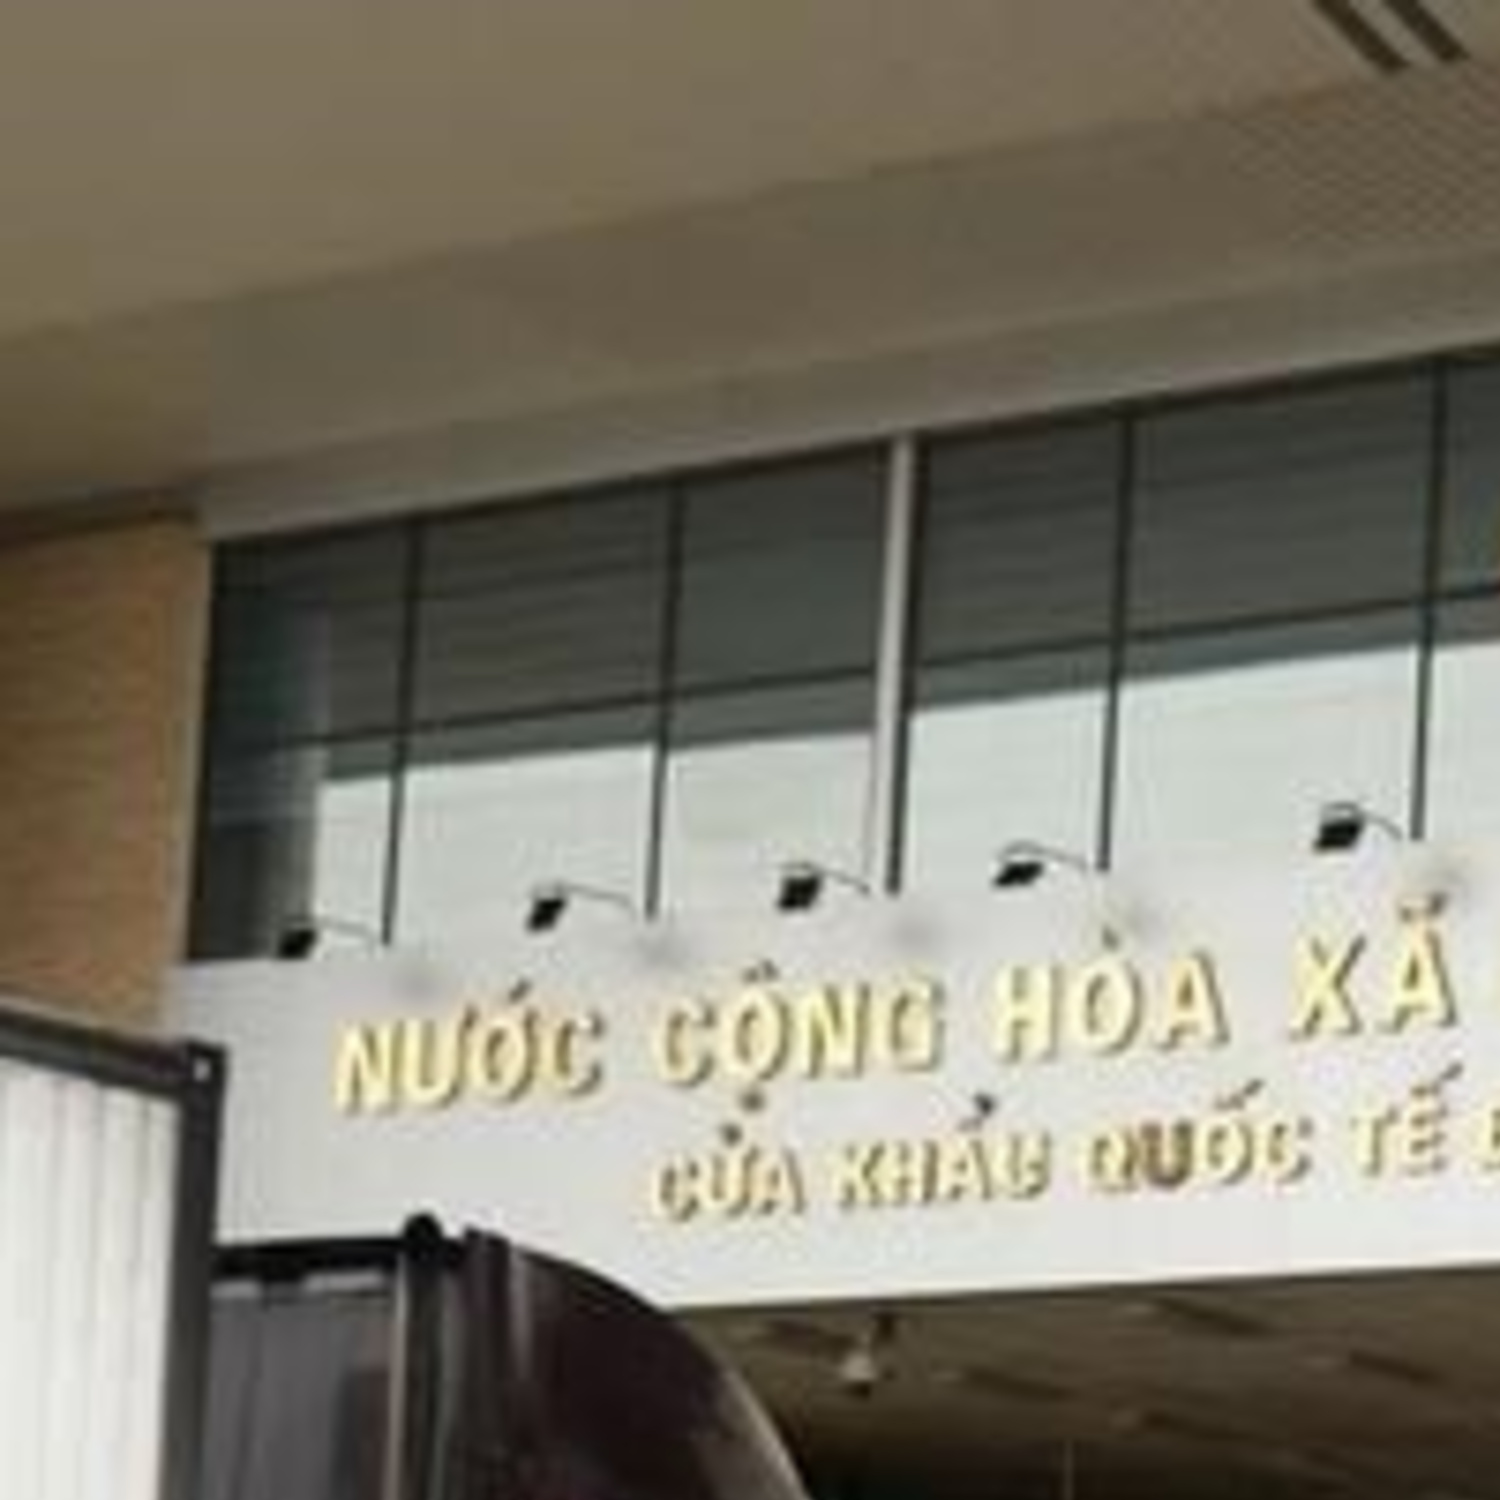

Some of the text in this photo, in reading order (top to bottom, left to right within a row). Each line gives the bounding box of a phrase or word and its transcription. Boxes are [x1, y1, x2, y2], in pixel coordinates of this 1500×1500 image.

[332, 980, 604, 1118] NƯỚC
[652, 960, 946, 1112] CỘNG
[993, 928, 1228, 1066] HÒA
[1288, 892, 1456, 1042] XÃ
[652, 1122, 805, 1222] CỬA
[1084, 1078, 1312, 1194] QUỐC
[1348, 1062, 1464, 1178] TẾ
